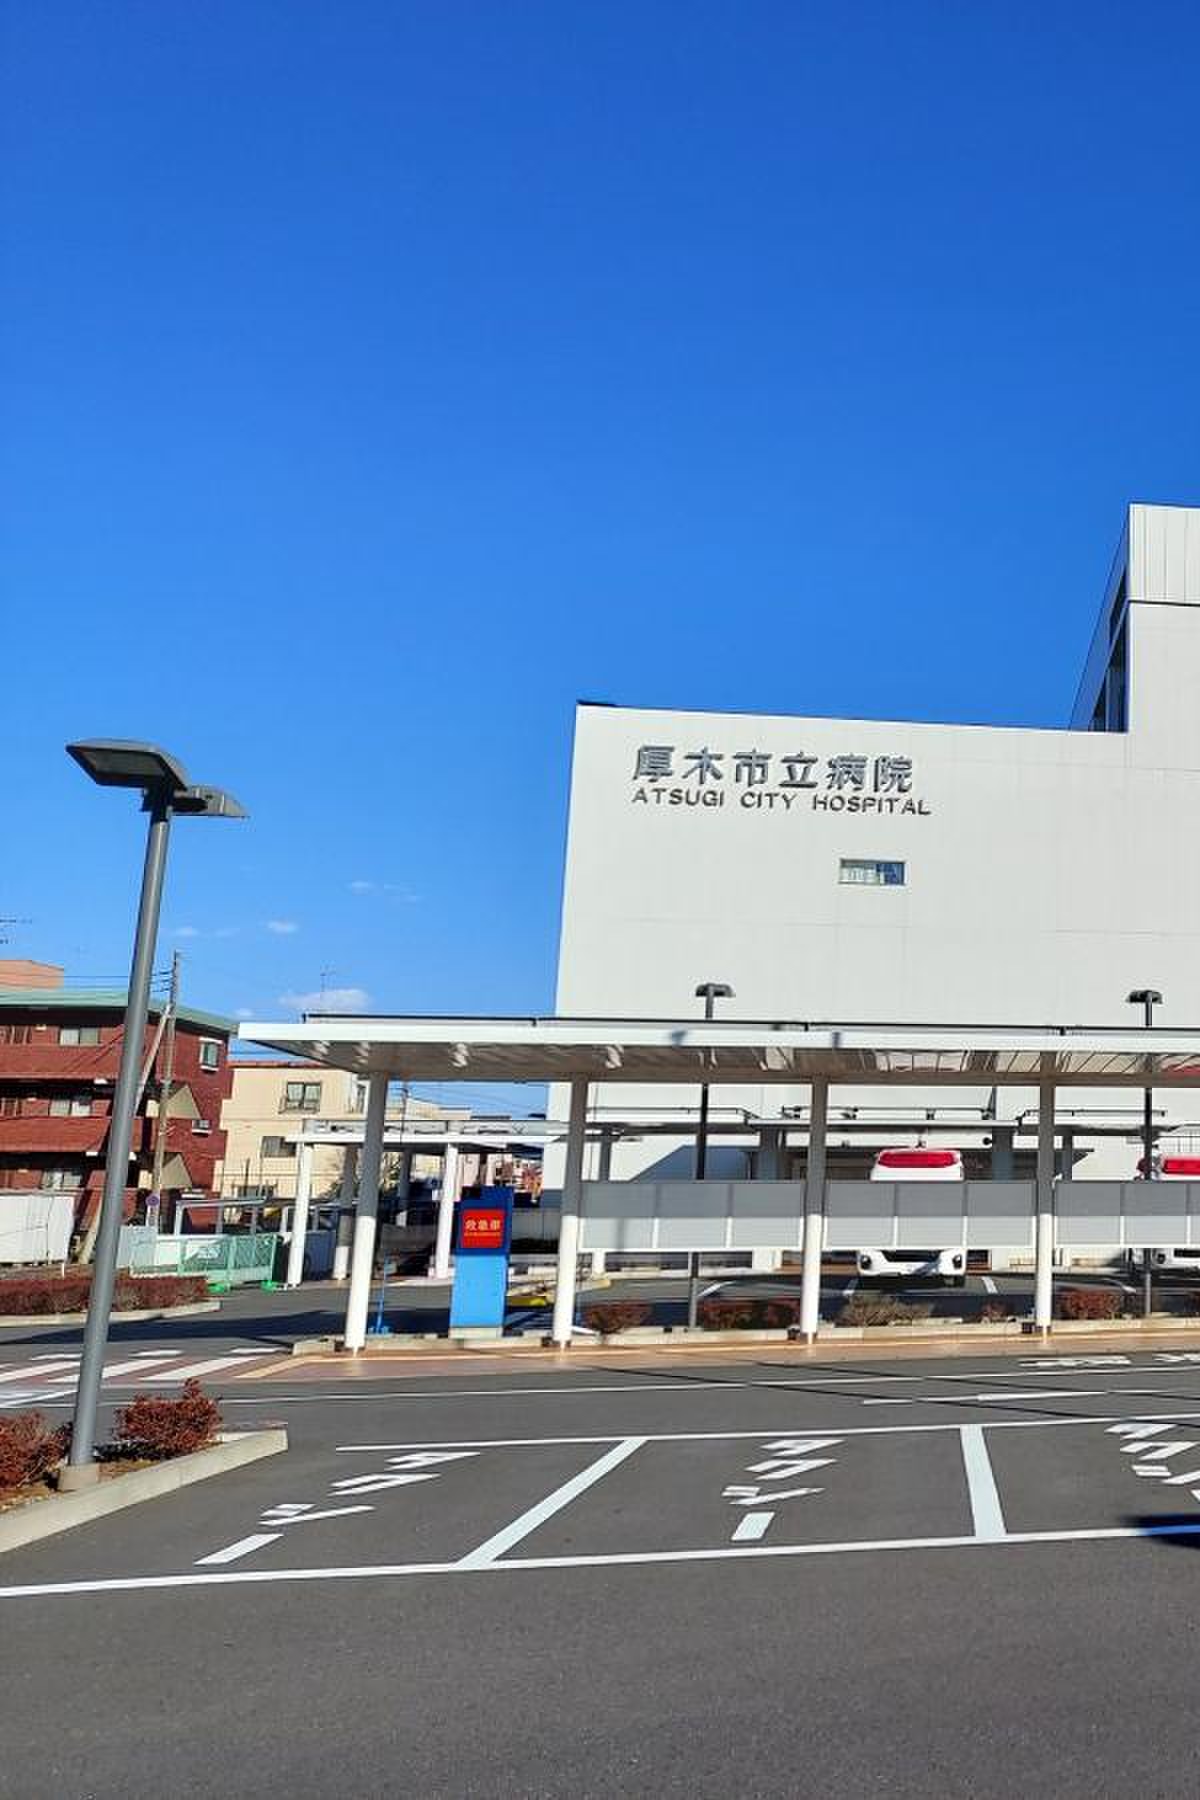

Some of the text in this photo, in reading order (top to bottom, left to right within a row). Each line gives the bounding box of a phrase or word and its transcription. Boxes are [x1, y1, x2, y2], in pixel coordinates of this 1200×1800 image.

[632, 746, 913, 794] 厚木市立病院
[632, 788, 932, 816] ATSUGI CITY HOSPITAL
[193, 1450, 481, 1565] タクシー
[721, 1439, 845, 1542] タクシー
